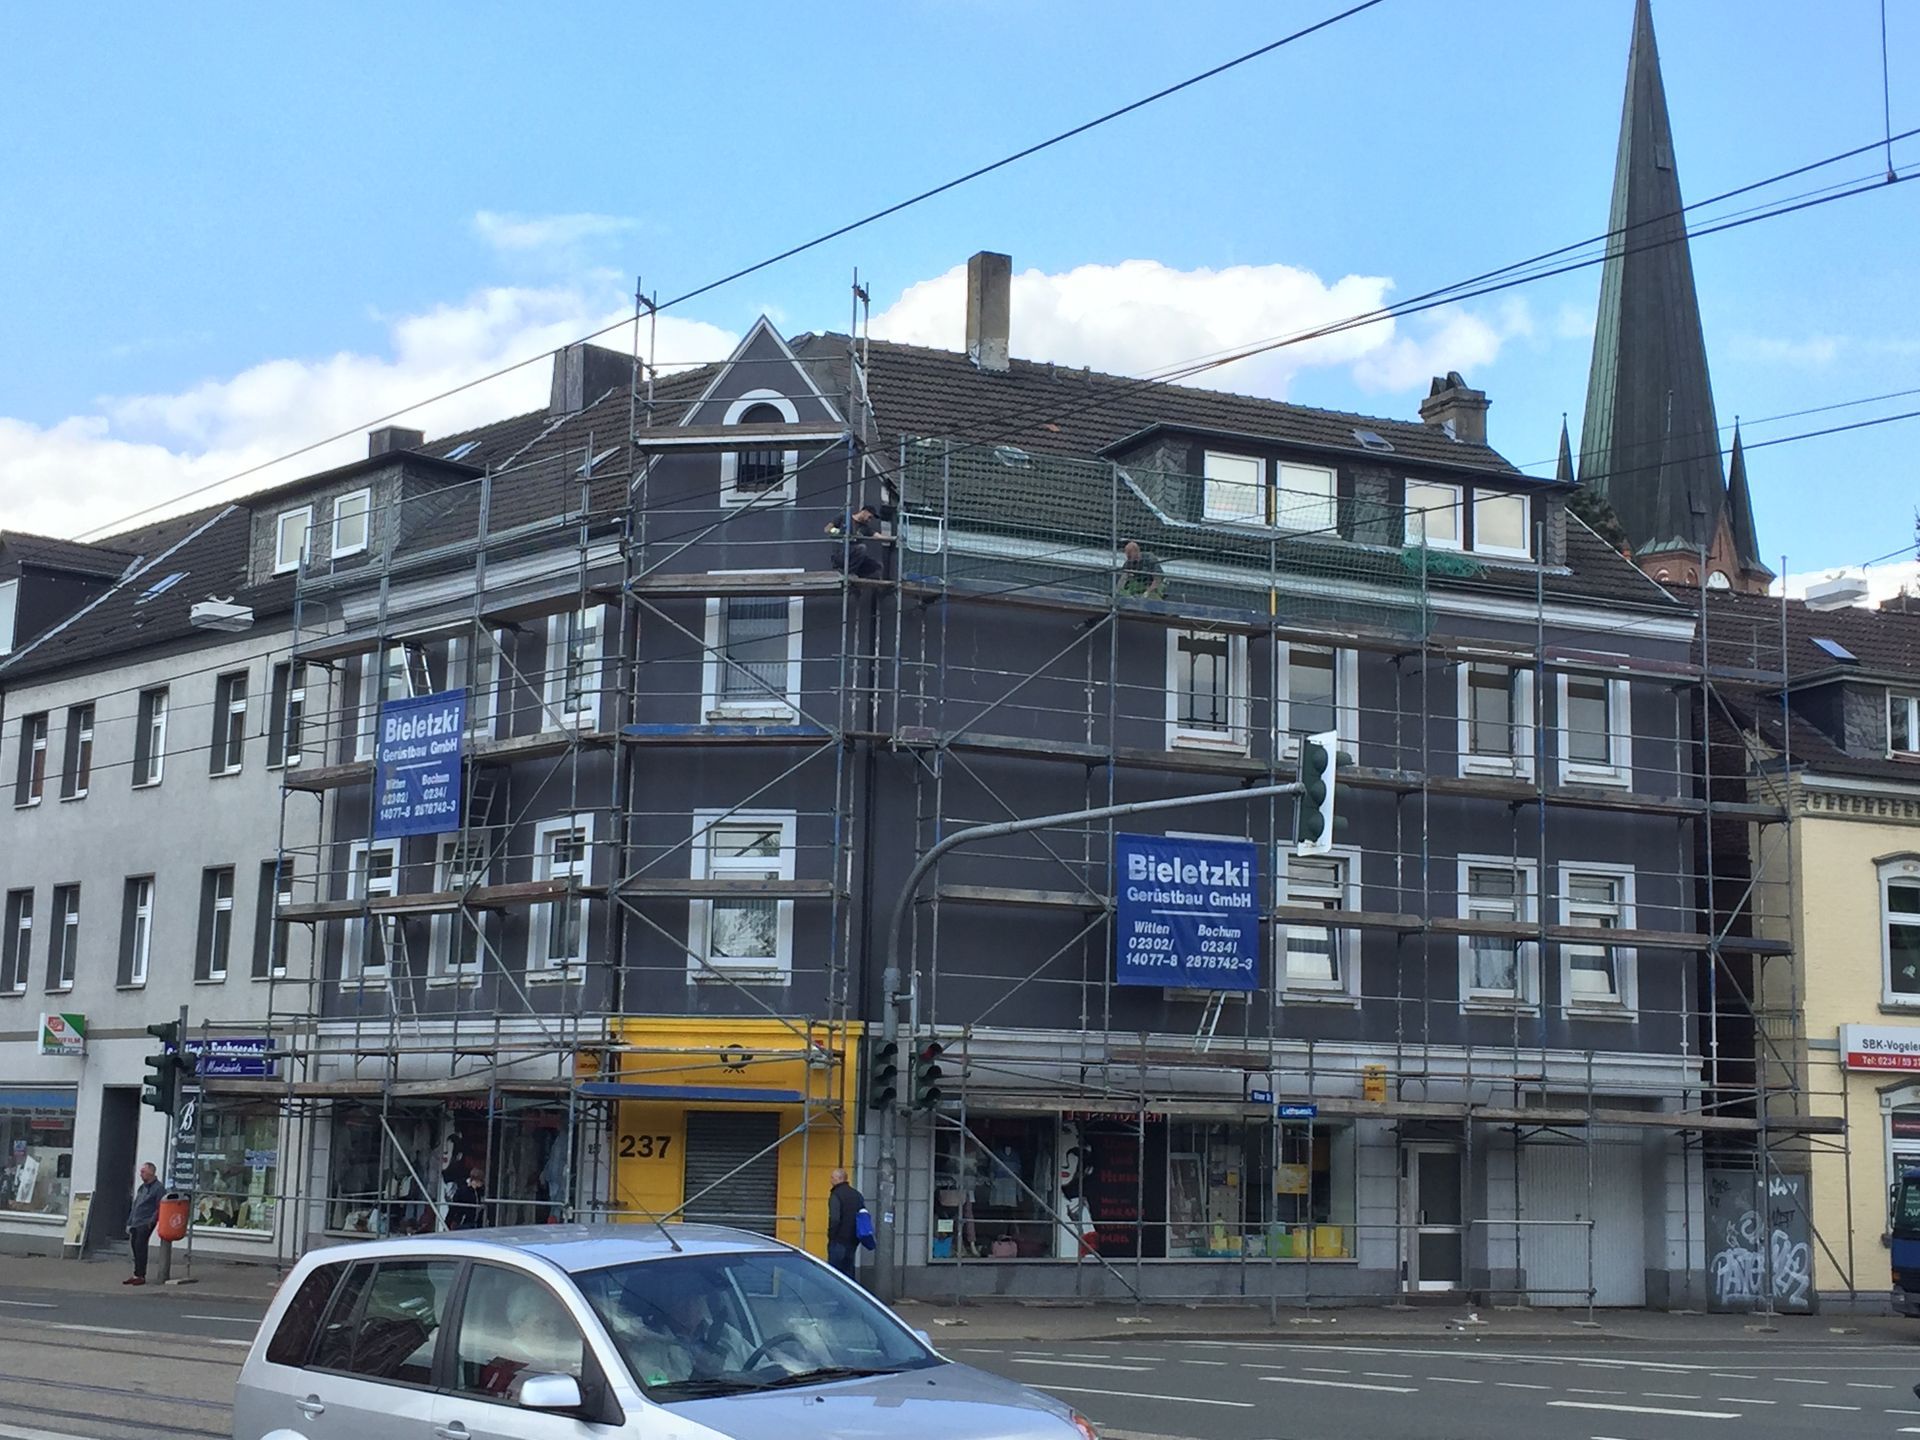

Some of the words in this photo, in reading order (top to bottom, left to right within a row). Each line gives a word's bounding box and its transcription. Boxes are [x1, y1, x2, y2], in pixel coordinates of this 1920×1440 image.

[385, 707, 460, 743] Bieletzki
[383, 745, 427, 762] Gerüstbau
[431, 738, 458, 755] GmbH
[422, 773, 449, 785] Bochum
[423, 787, 447, 800] 0234/
[1128, 853, 1250, 887] Bieletzki
[1127, 886, 1203, 905] Gerüstbau
[1209, 892, 1251, 907] GmbH
[1134, 921, 1170, 934] Witten
[1198, 924, 1241, 938] Bochum
[1128, 937, 1174, 950] 02302/
[1201, 941, 1237, 954] 0234/
[1126, 954, 1178, 967] 14077-8
[1186, 955, 1253, 970] 2878742-3
[619, 1135, 672, 1159] 237
